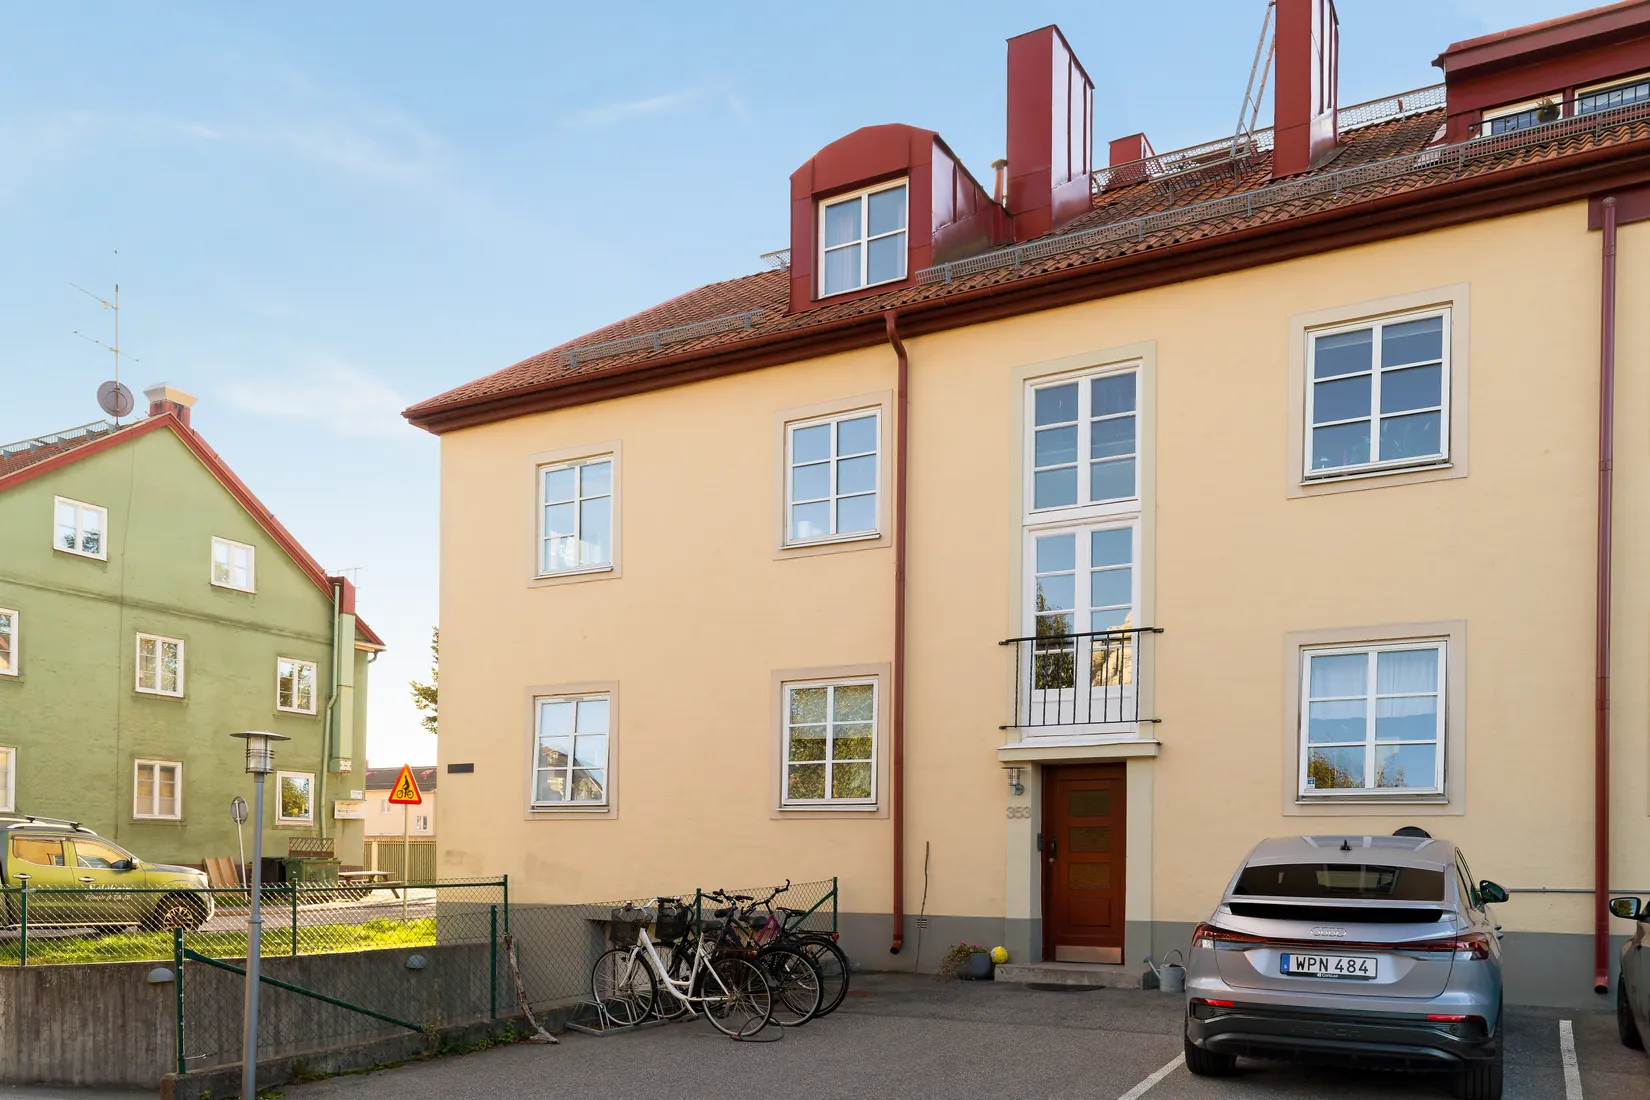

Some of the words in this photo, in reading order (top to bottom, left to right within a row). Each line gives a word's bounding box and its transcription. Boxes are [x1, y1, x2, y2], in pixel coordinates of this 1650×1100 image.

[1006, 806, 1031, 819] 353
[1296, 956, 1329, 972] WPN
[1334, 958, 1369, 975] 484
